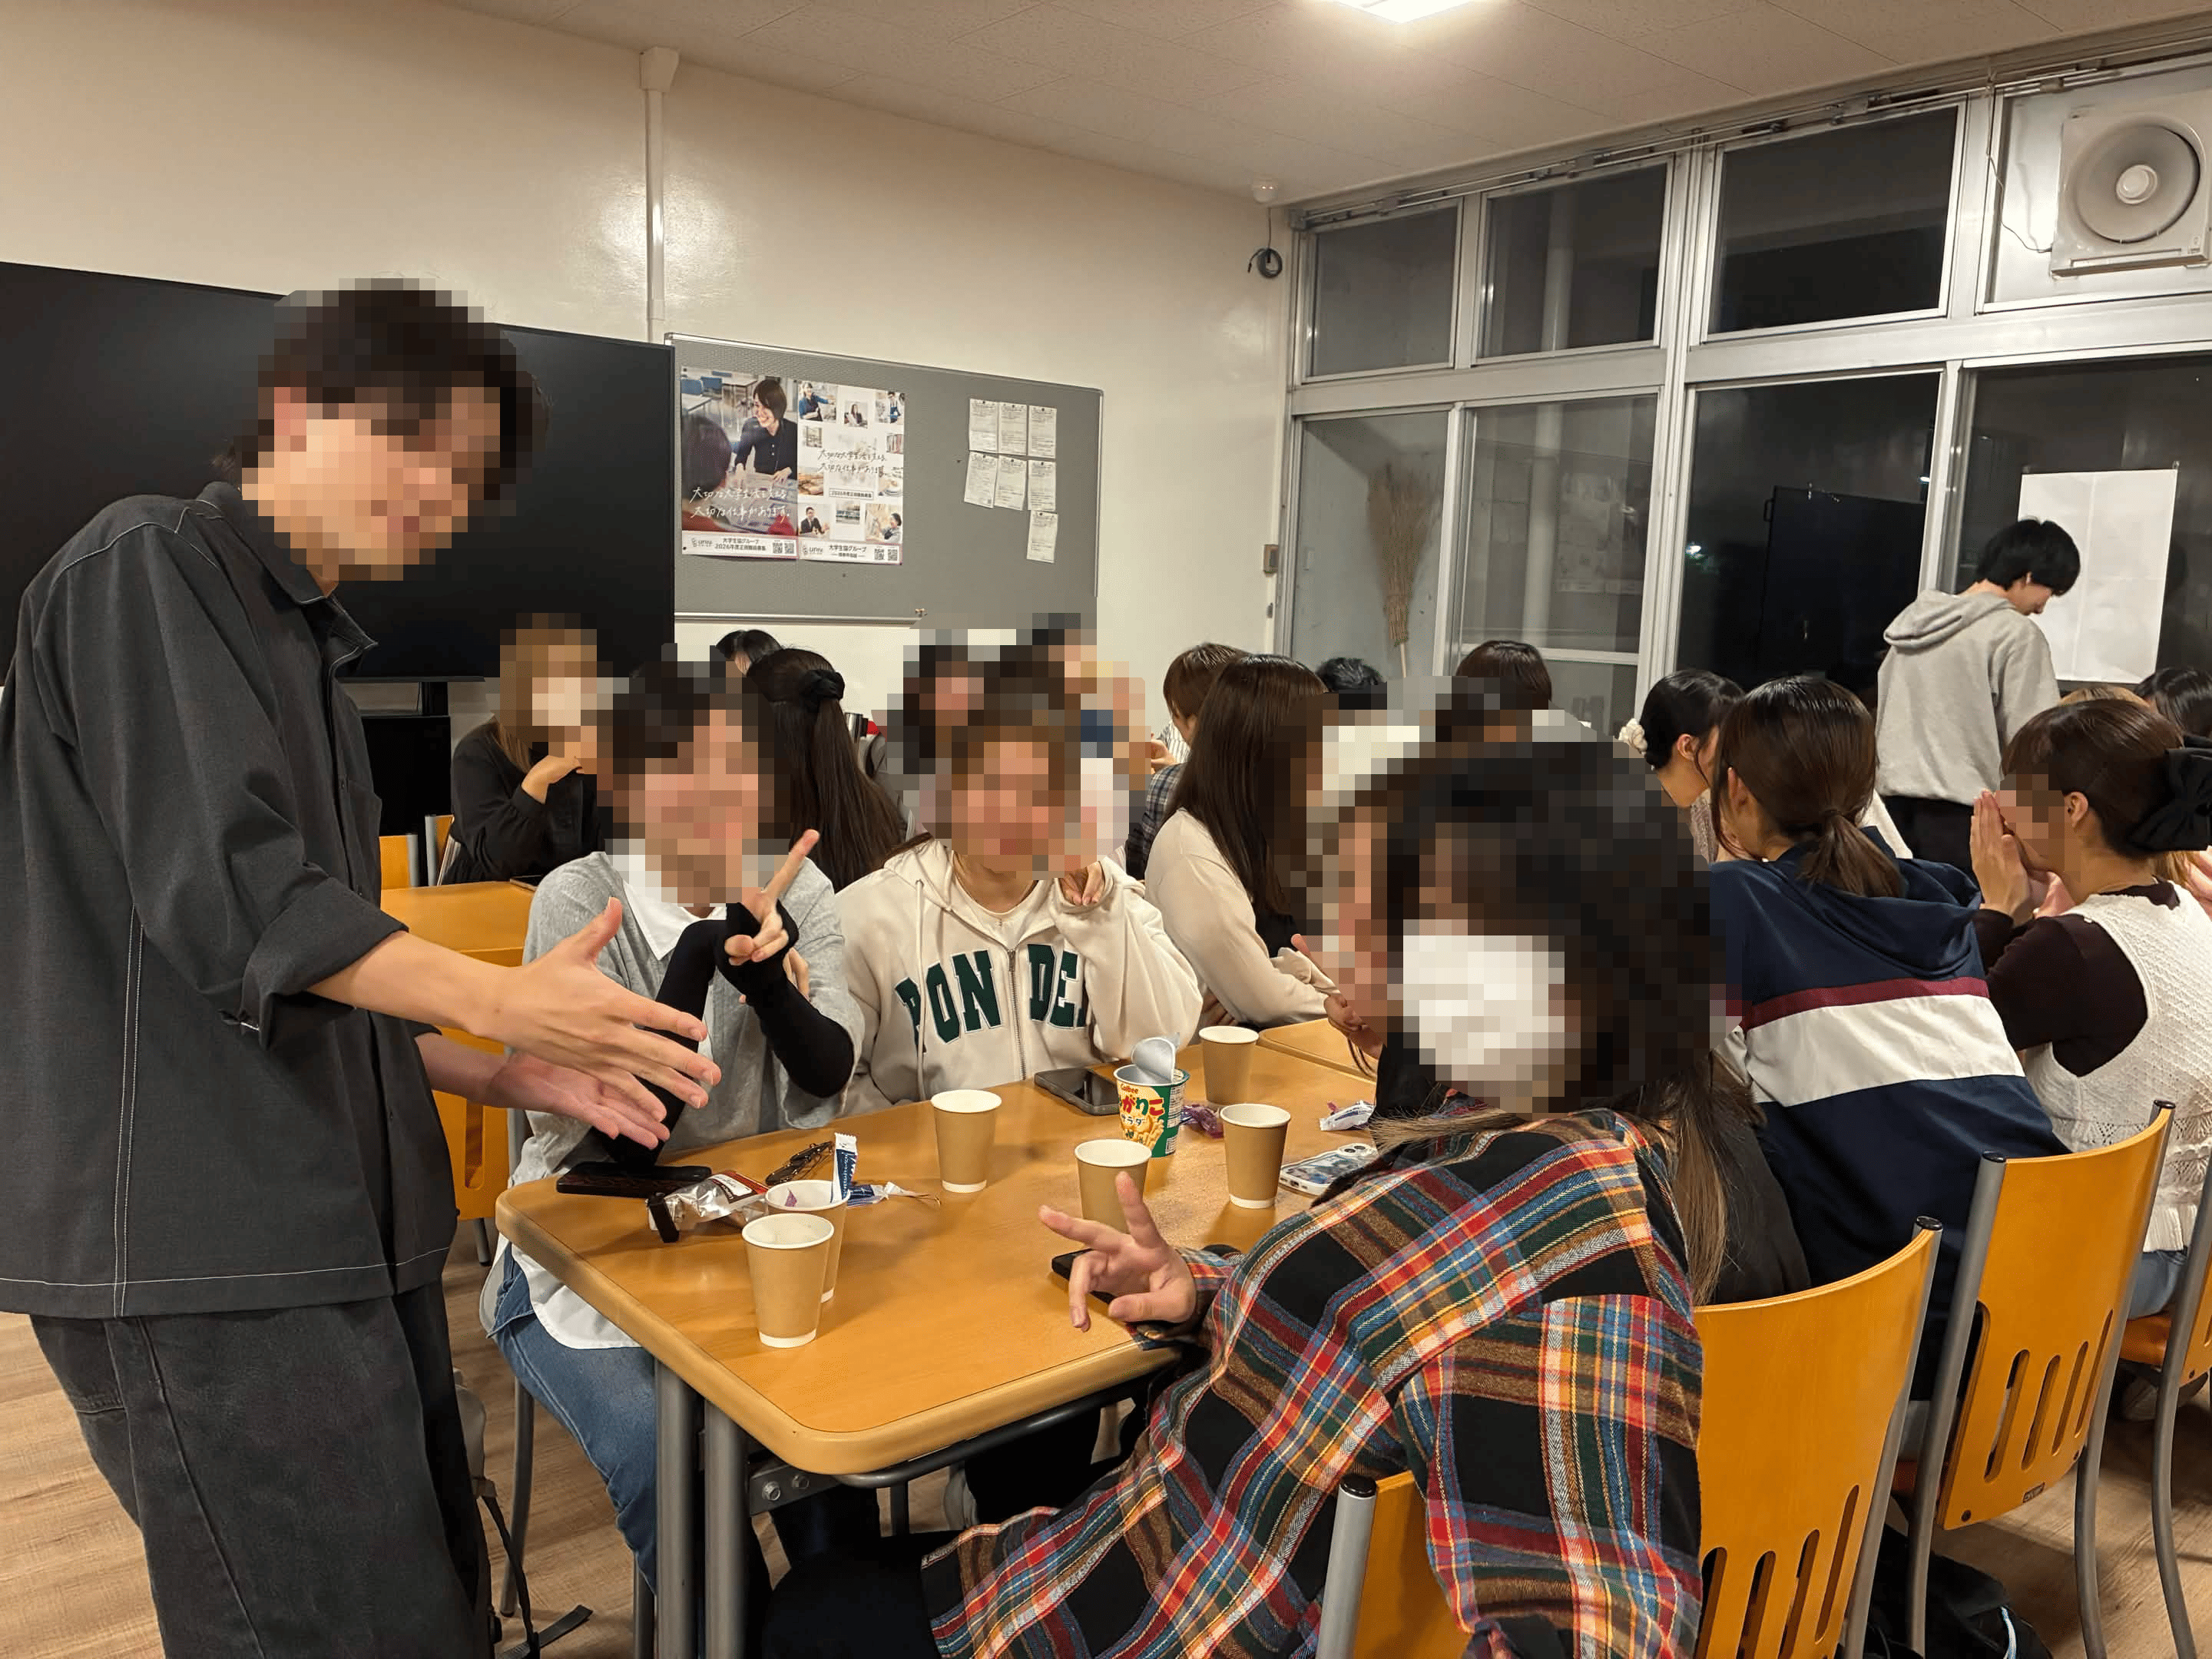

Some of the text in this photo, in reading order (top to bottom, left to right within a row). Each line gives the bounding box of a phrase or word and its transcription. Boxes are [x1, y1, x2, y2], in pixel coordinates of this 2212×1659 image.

[1121, 1083, 1139, 1094] Calbee
[1118, 1094, 1166, 1117] がりこ
[1121, 1114, 1146, 1126] サラダ
